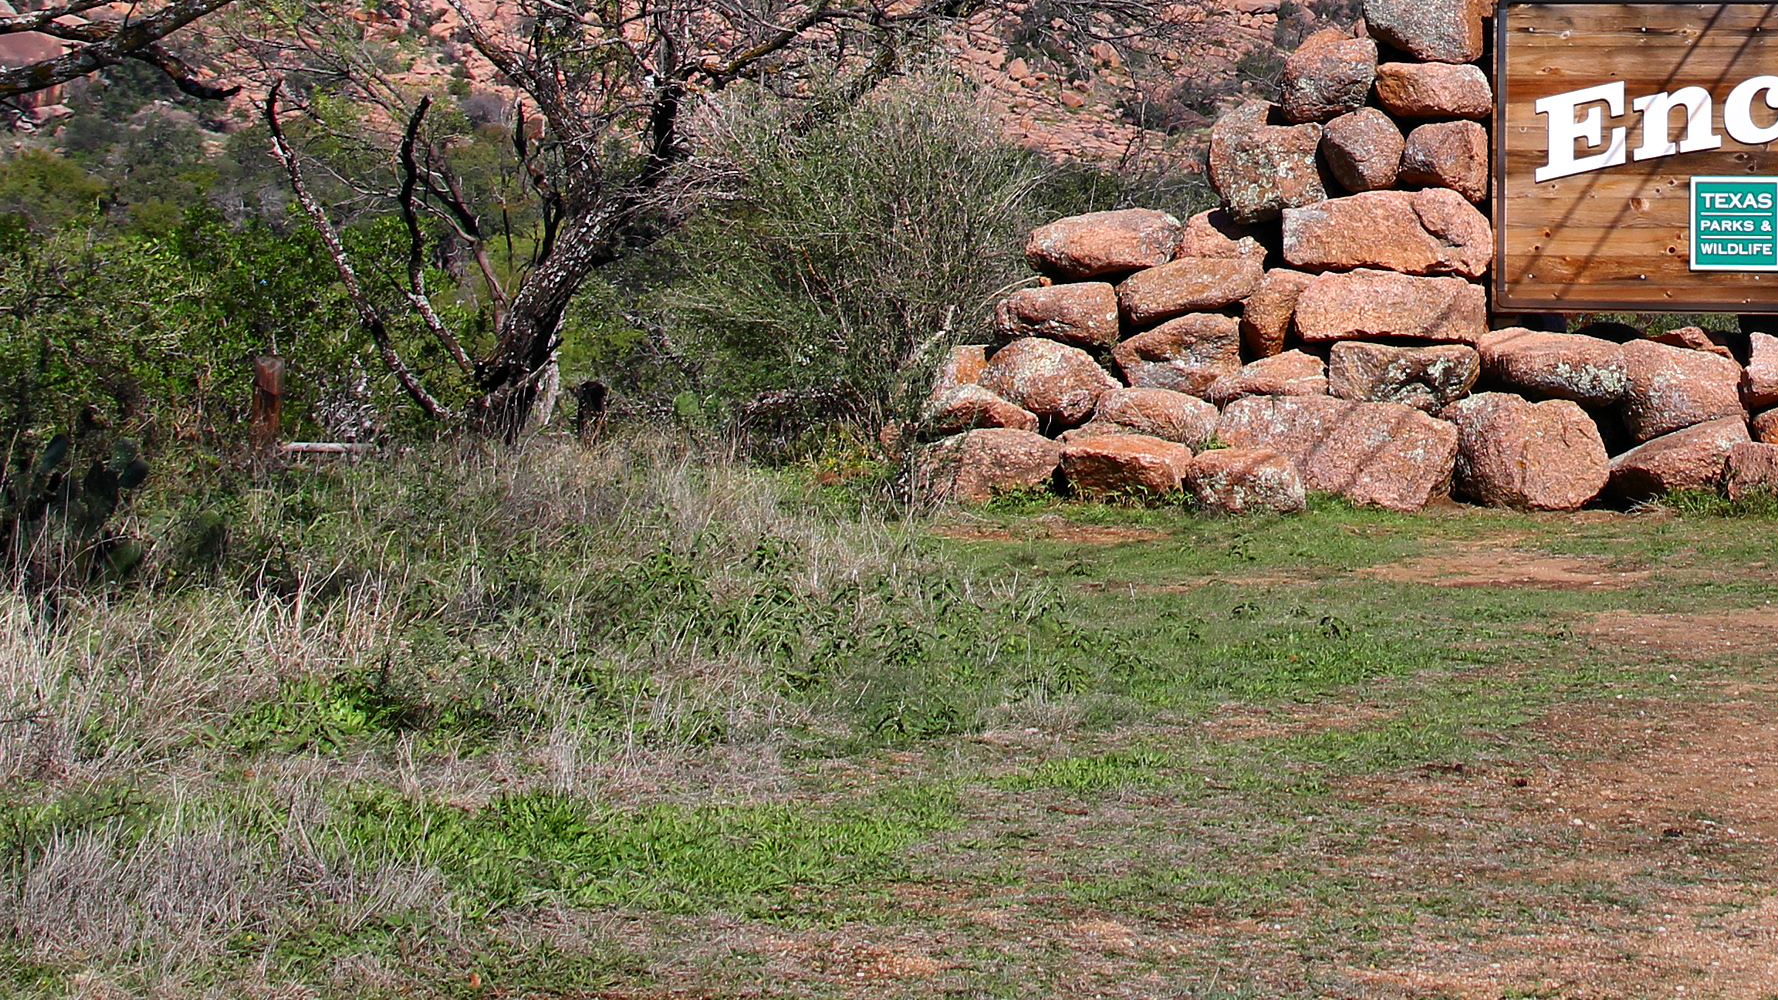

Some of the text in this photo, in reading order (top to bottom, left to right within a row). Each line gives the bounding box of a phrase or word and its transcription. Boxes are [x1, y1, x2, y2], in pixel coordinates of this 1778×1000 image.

[1700, 192, 1773, 209] TEXAS
[1700, 219, 1772, 232] PARKS &
[1700, 242, 1773, 255] WILDLIFE
